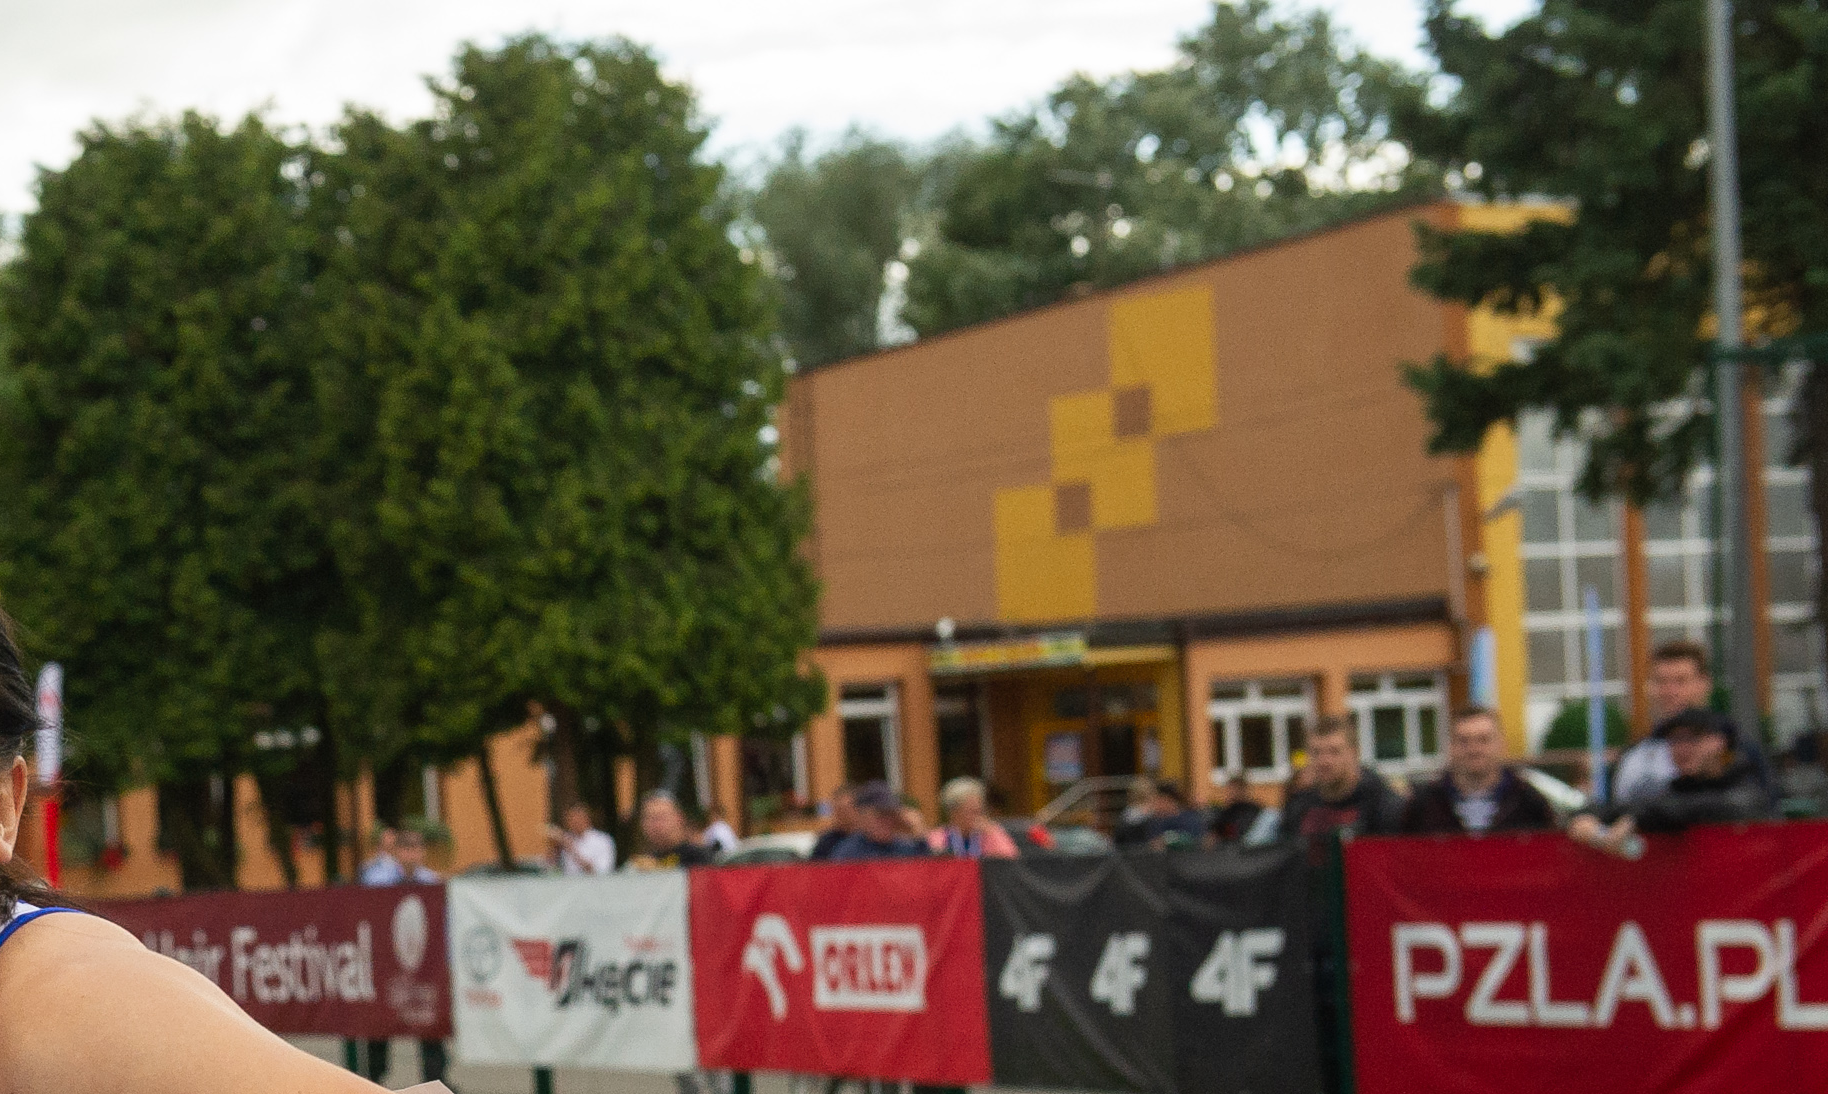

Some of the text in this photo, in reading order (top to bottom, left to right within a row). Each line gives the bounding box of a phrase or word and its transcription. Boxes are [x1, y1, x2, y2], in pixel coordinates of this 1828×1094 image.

[231, 925, 375, 1001] Festival
[824, 941, 917, 993] ORLEN
[999, 932, 1057, 1012] 4F
[1090, 931, 1151, 1015] 4F
[1189, 926, 1285, 1017] 4F
[1392, 917, 1828, 1031] PZLA.PL
